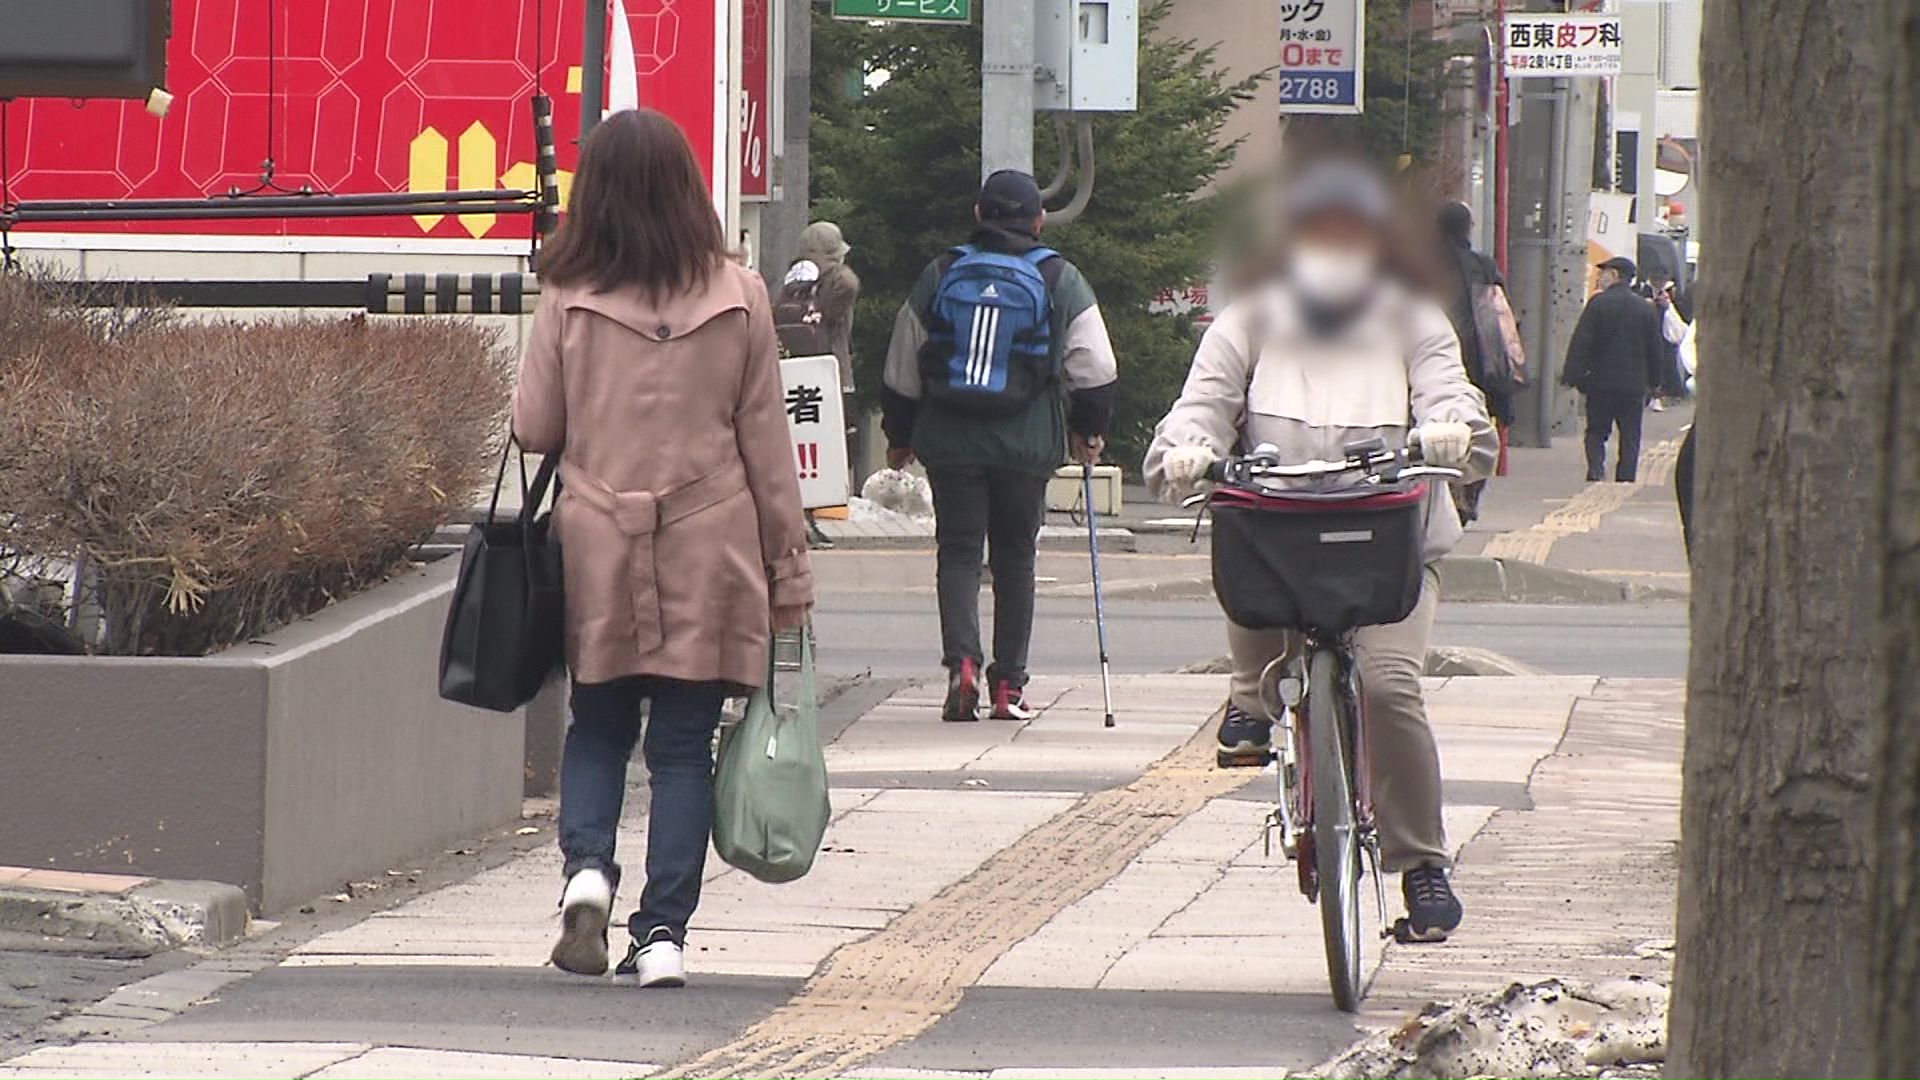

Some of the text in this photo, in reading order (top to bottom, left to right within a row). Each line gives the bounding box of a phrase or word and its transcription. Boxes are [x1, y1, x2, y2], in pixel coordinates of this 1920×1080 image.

[1510, 22, 1621, 48] 西東皮フ科
[1280, 77, 1339, 99] 2788
[785, 384, 824, 424] 者
